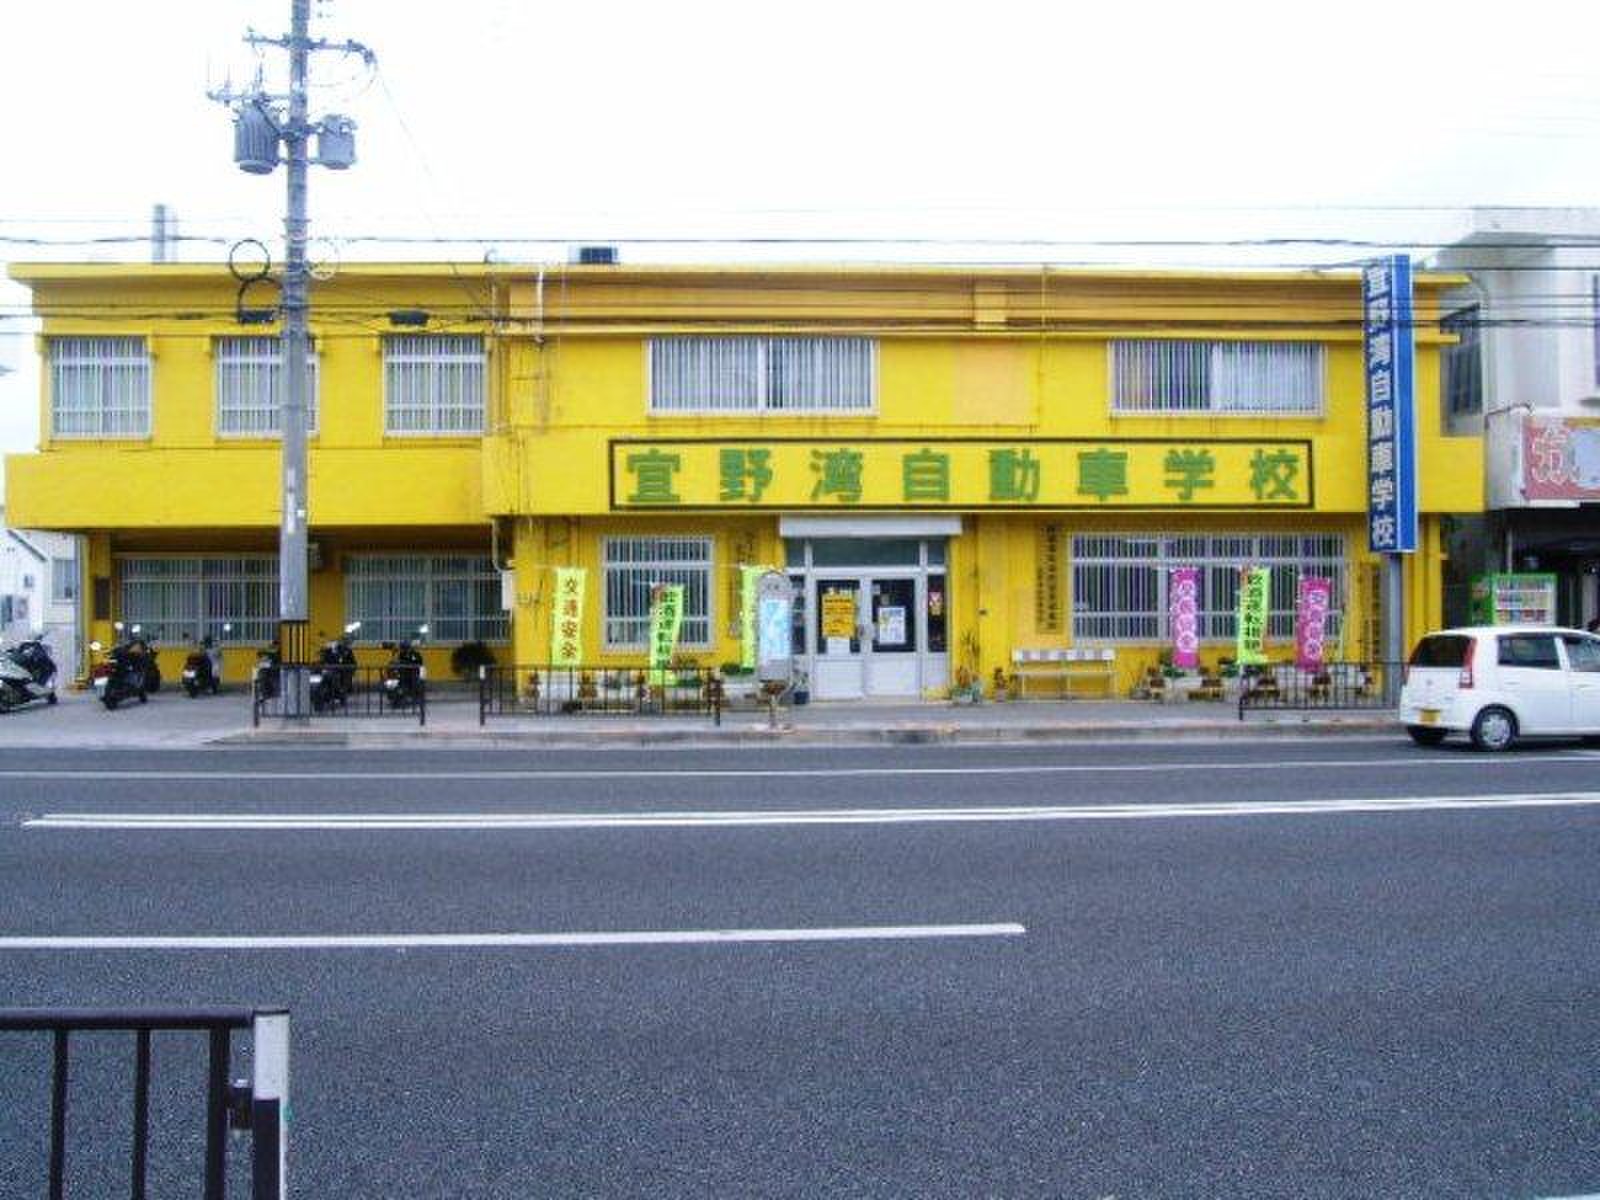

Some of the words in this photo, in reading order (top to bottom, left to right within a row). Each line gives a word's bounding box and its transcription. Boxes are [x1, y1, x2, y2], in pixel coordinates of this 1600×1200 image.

[626, 448, 1299, 504] 宜野湾自動車学校
